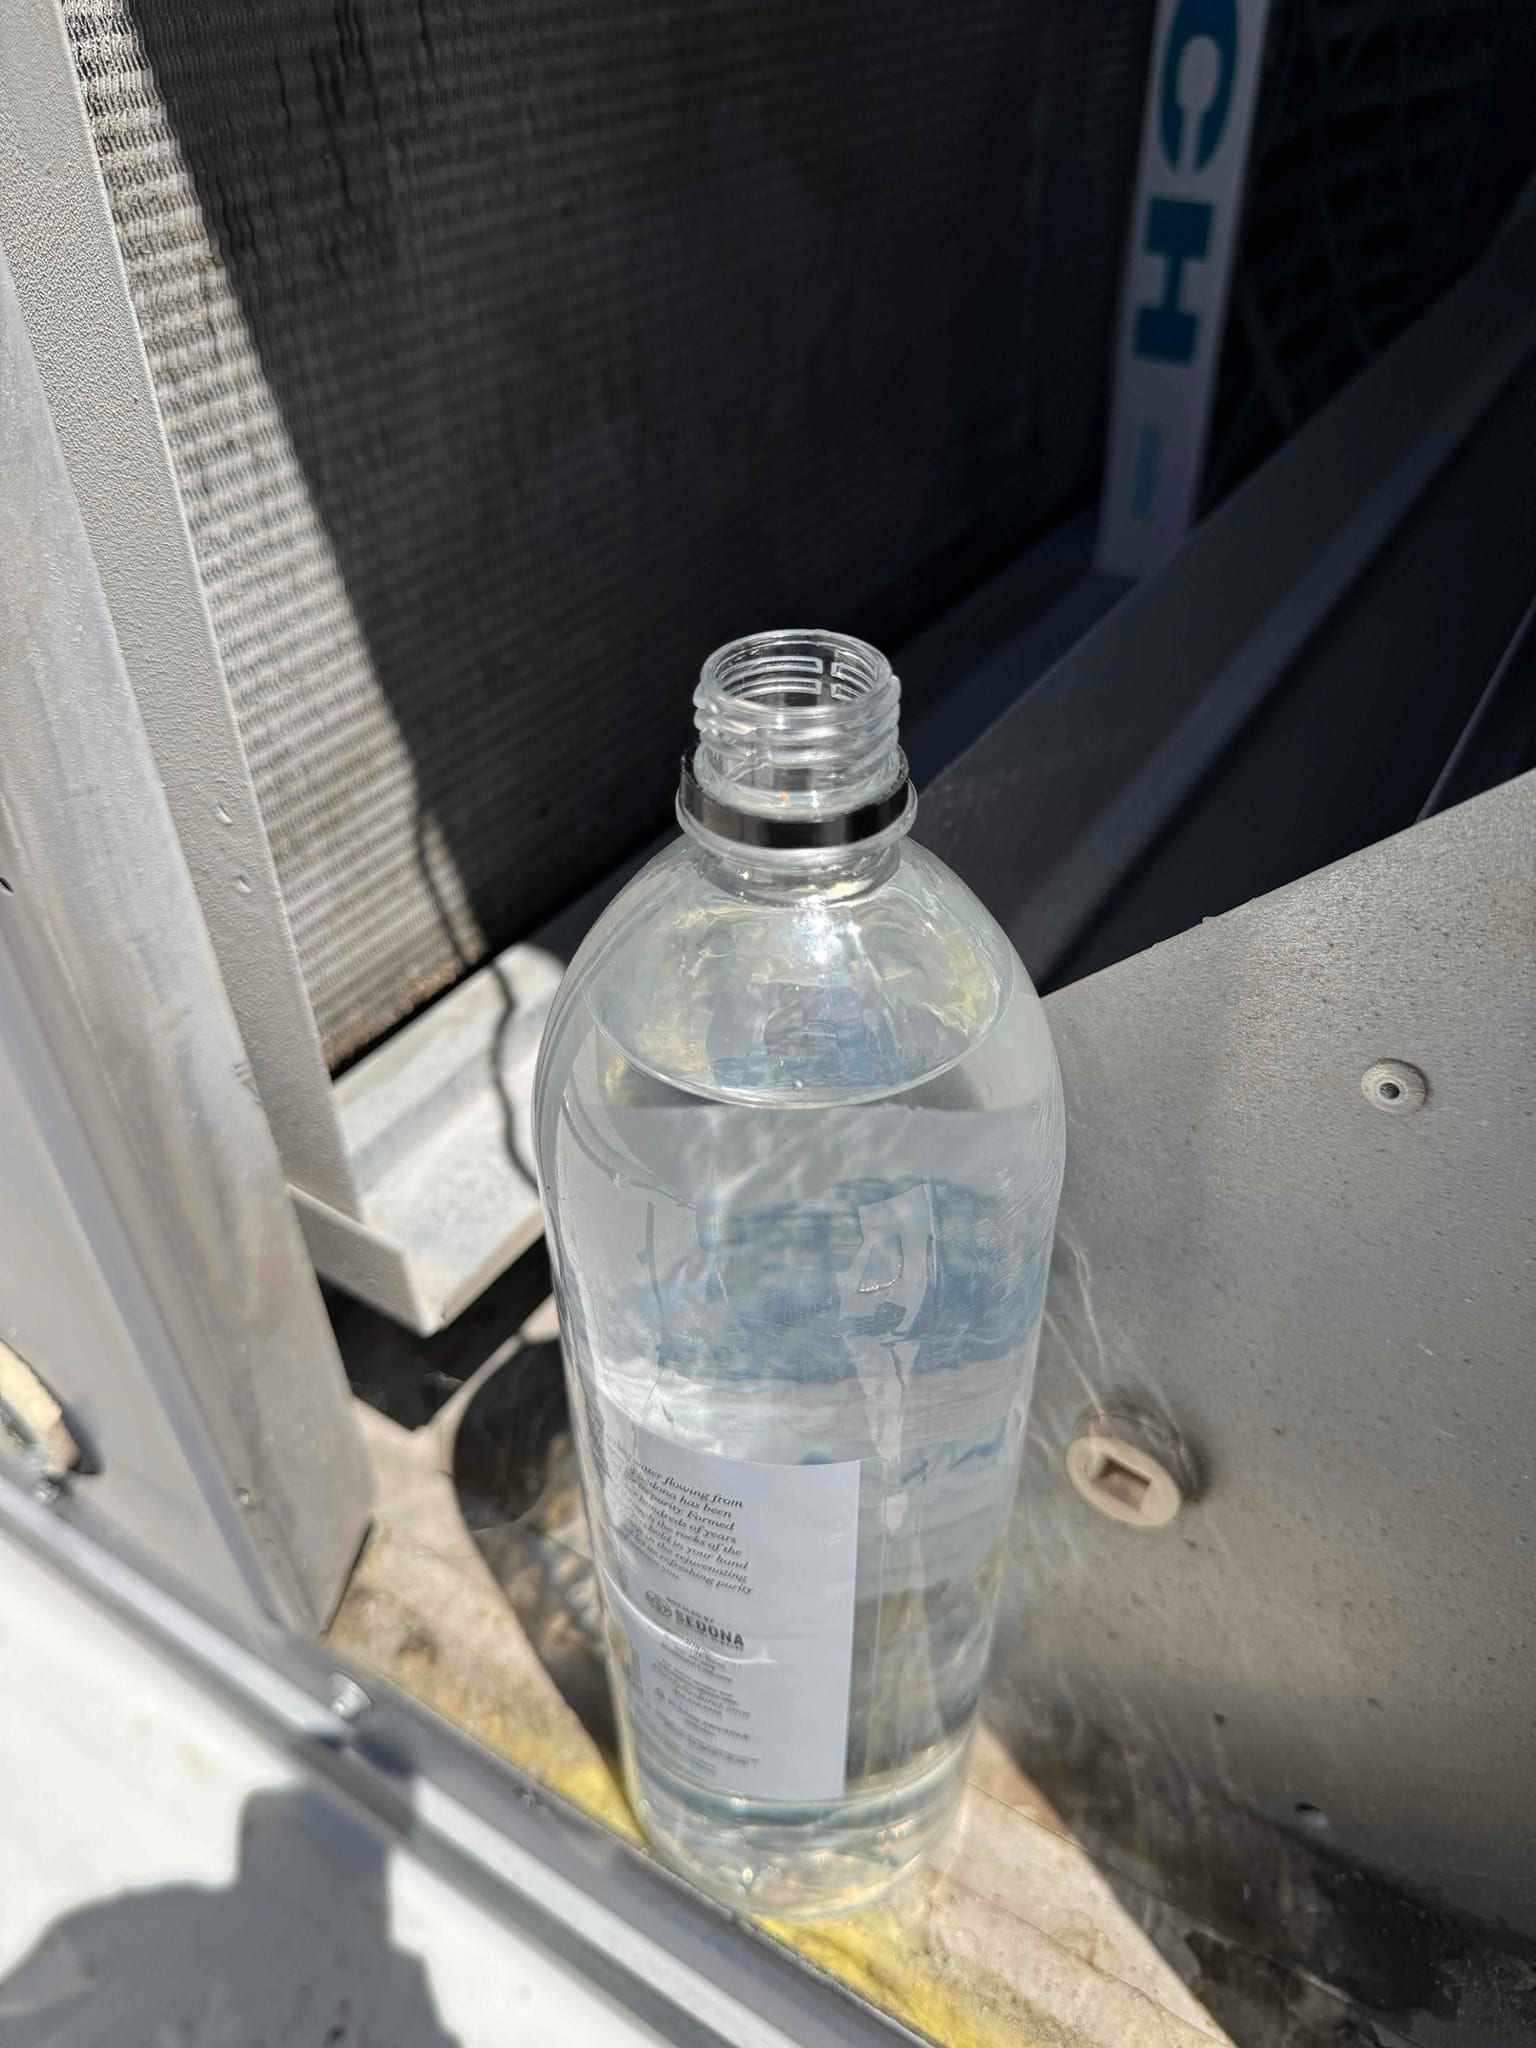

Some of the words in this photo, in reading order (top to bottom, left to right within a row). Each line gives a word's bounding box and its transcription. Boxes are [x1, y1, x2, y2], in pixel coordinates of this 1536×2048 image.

[662, 1476, 710, 1502] flowing
[709, 1493, 744, 1508] from
[679, 1494, 701, 1509] has
[703, 1504, 732, 1518] been
[639, 1495, 687, 1528] hundreds
[689, 1524, 704, 1535] of
[703, 1528, 737, 1544] years
[687, 1510, 736, 1531] Formed
[675, 1530, 705, 1547] rocks
[707, 1541, 724, 1551] of
[723, 1545, 743, 1556] the
[675, 1550, 748, 1584] rejuvenating
[684, 1545, 714, 1561] your
[715, 1554, 750, 1570] hand
[715, 1579, 753, 1594] purity
[675, 1608, 745, 1648] SEDONA
